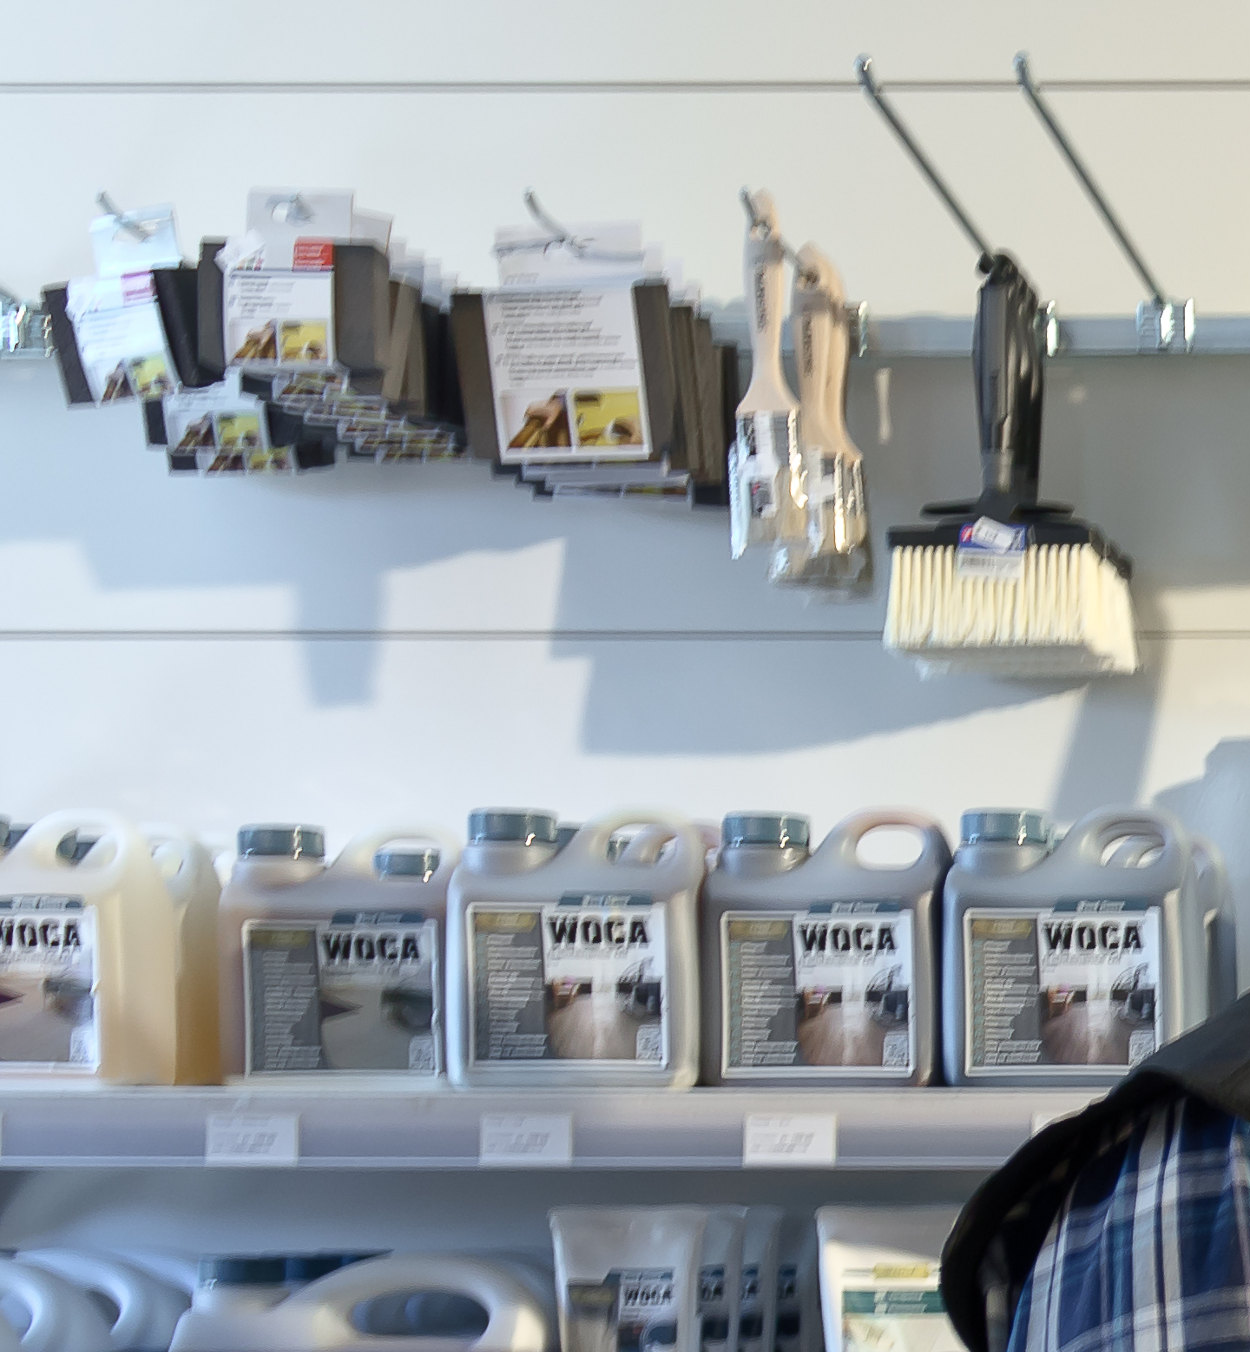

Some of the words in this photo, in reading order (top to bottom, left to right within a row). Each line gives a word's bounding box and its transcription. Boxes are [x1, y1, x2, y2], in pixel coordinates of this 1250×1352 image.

[548, 916, 650, 945] WOCA
[800, 922, 896, 951] WOCA
[1043, 920, 1142, 950] WOCA
[322, 931, 419, 961] WOCA
